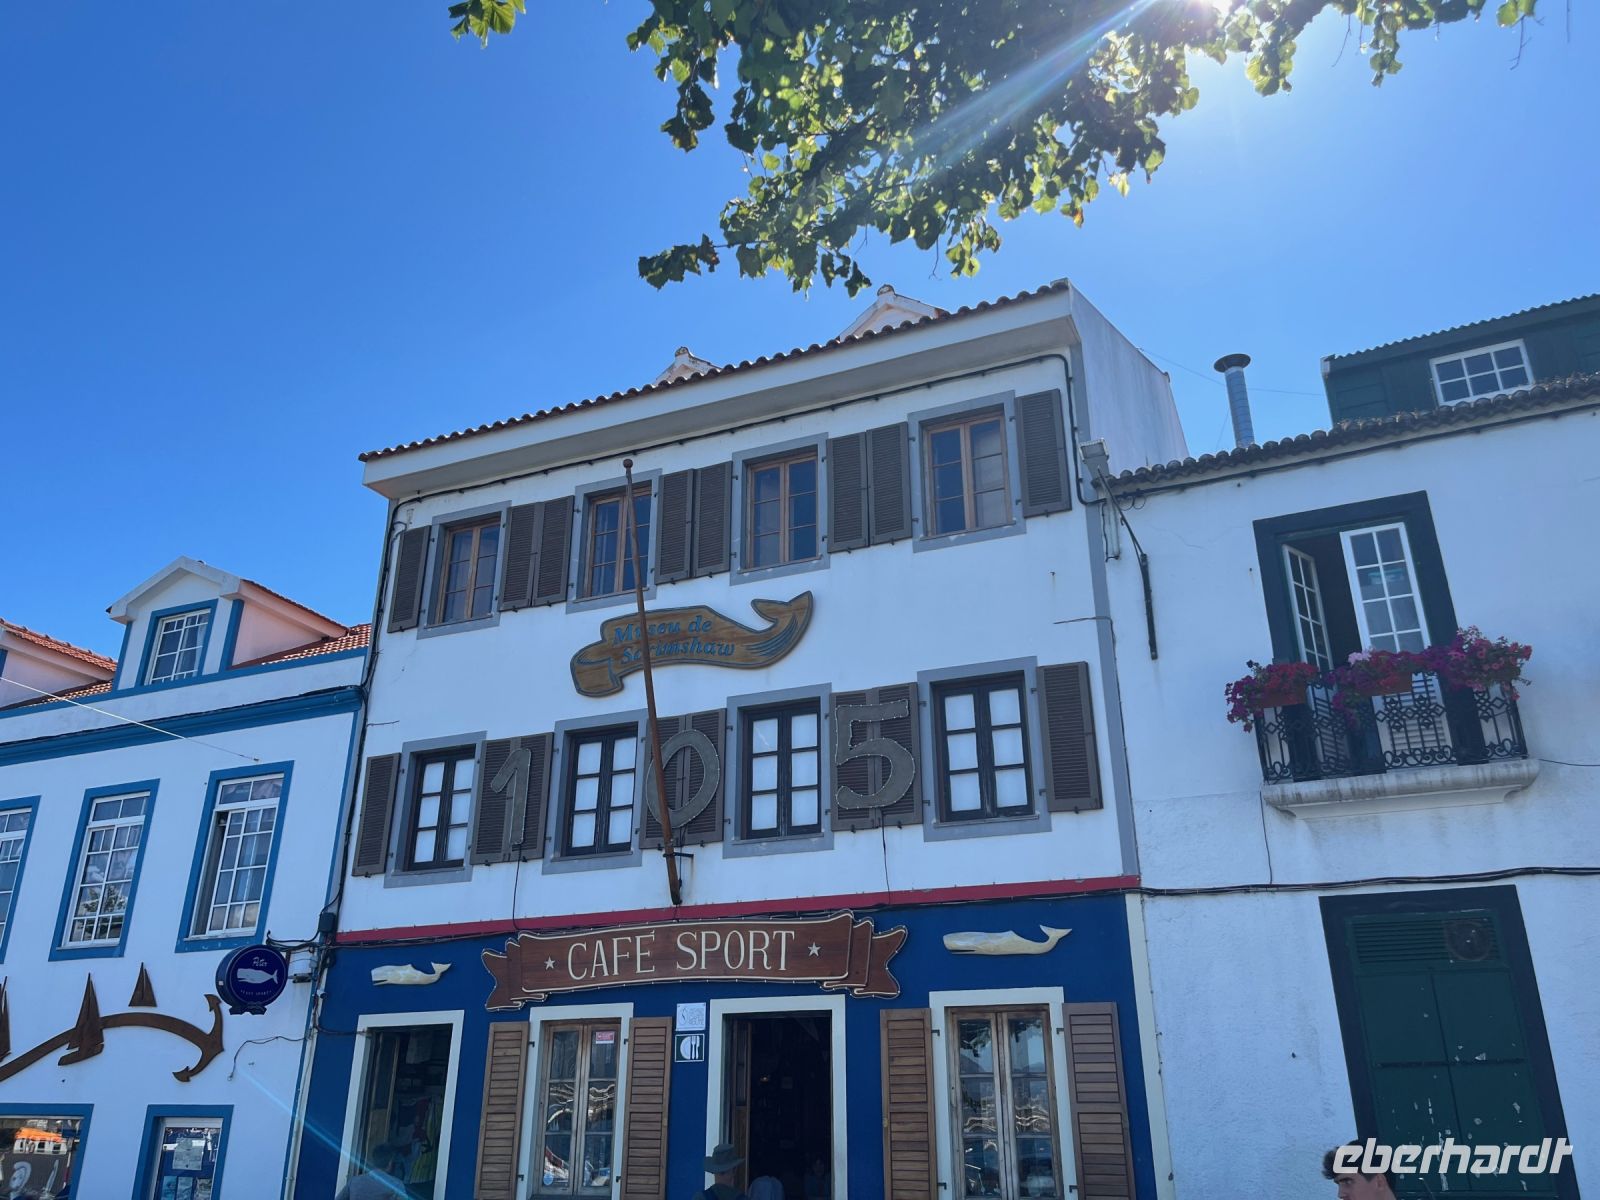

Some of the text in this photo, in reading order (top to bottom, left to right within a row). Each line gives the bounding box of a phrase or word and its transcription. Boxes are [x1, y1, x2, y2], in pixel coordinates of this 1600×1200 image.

[688, 615, 713, 633] de
[568, 930, 795, 980] CAFÉ SPORT
